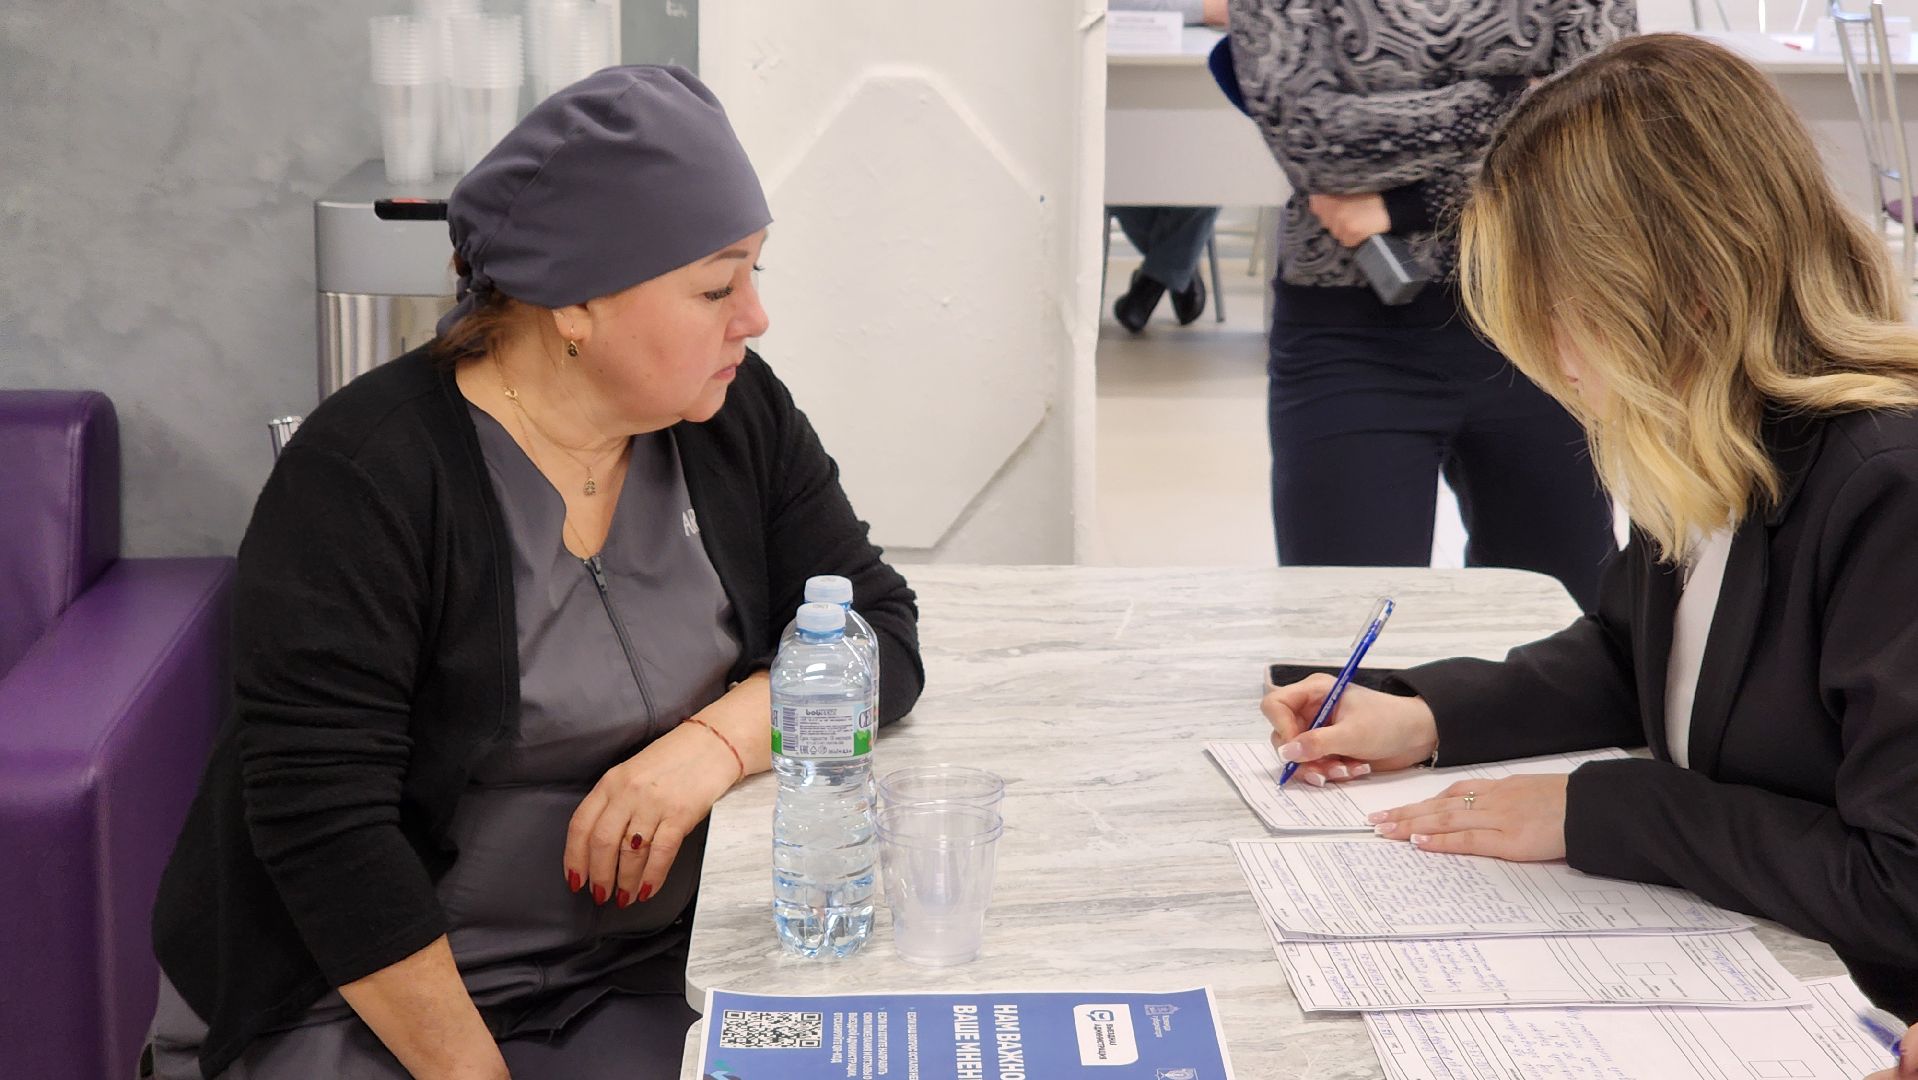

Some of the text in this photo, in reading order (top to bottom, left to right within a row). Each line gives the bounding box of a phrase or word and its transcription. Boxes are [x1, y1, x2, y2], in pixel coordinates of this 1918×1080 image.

[953, 1005, 983, 1080] ВАШЕ МНЕН
[993, 1004, 1026, 1080] НАМ ВАЖНО
